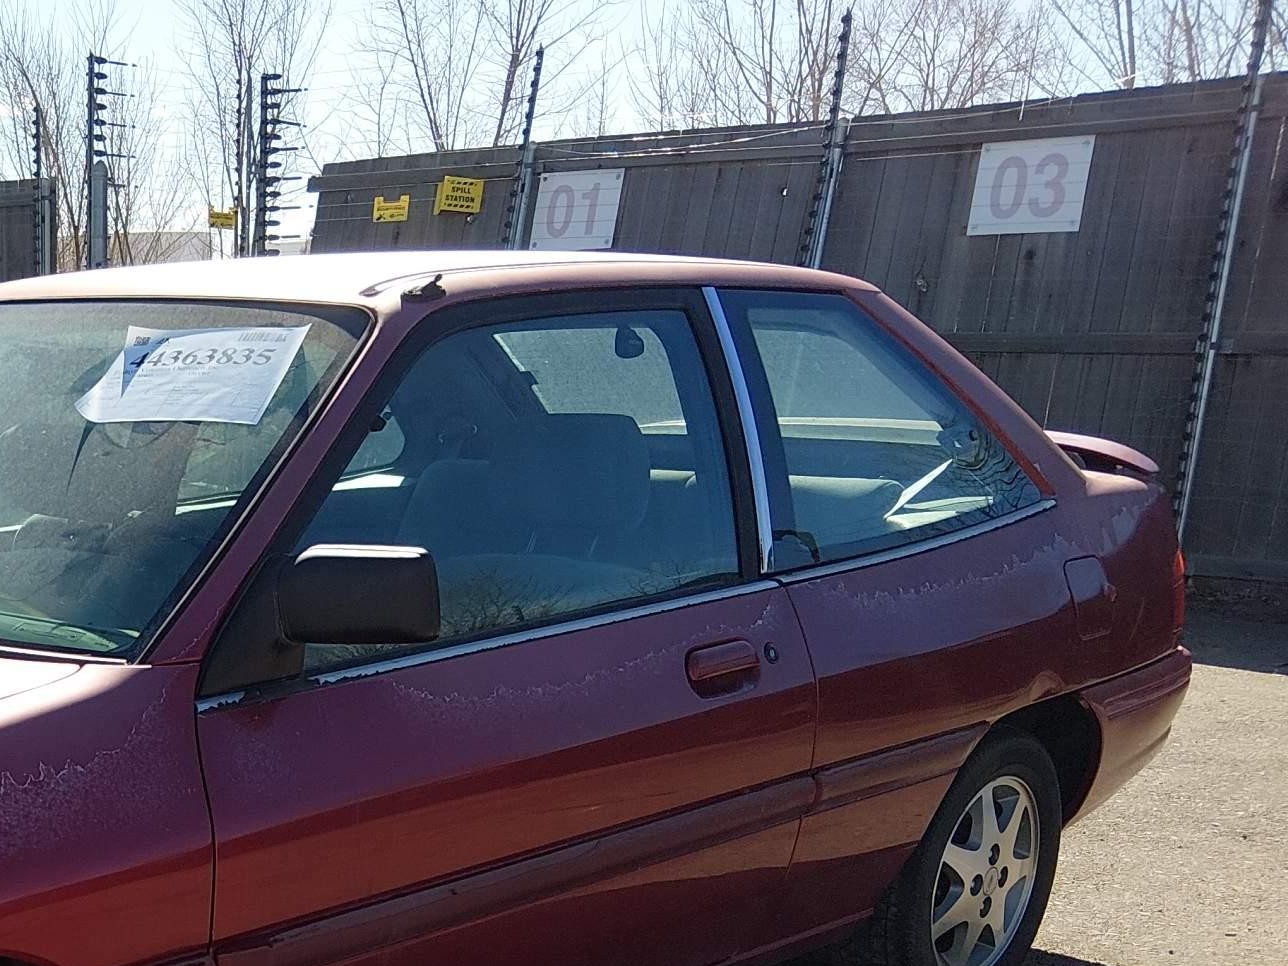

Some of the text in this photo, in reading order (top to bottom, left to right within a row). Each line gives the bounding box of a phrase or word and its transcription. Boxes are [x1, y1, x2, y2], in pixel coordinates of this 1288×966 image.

[451, 186, 472, 194] SPILL
[990, 152, 1069, 219] 03
[445, 194, 475, 203] STATION
[546, 182, 601, 239] 01
[129, 347, 277, 369] 44363835
